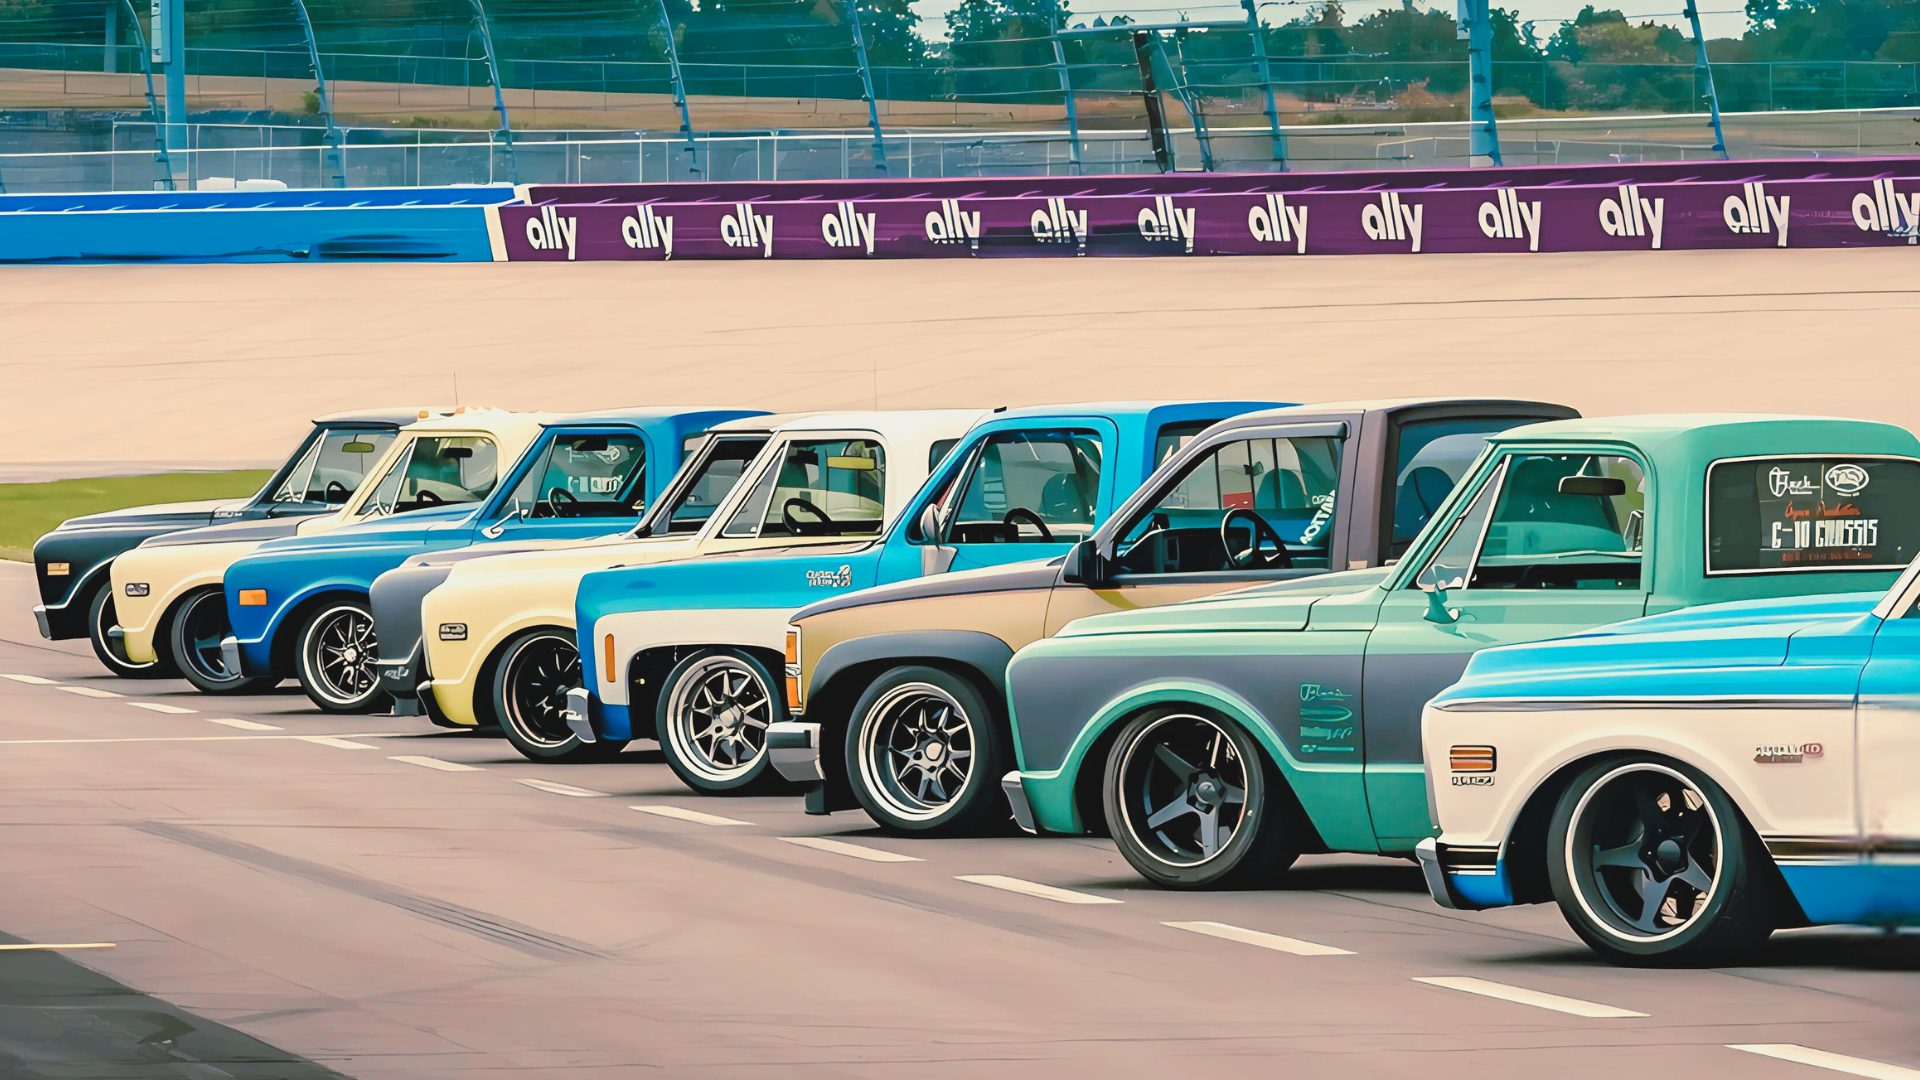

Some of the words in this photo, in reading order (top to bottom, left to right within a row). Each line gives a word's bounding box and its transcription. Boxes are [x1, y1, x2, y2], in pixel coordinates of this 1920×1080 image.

[526, 205, 576, 259] ally
[622, 204, 672, 260] ally
[721, 203, 773, 257] ally
[822, 202, 875, 257] ally
[926, 199, 980, 256] ally
[1031, 198, 1087, 255] ally
[1138, 196, 1195, 254] ally
[1249, 194, 1307, 253] ally
[1362, 192, 1422, 251] ally
[1478, 188, 1541, 251] ally
[1599, 185, 1663, 248] ally
[1723, 183, 1790, 246] ally
[1852, 179, 1920, 244] ally
[1771, 521, 1810, 549] C-10
